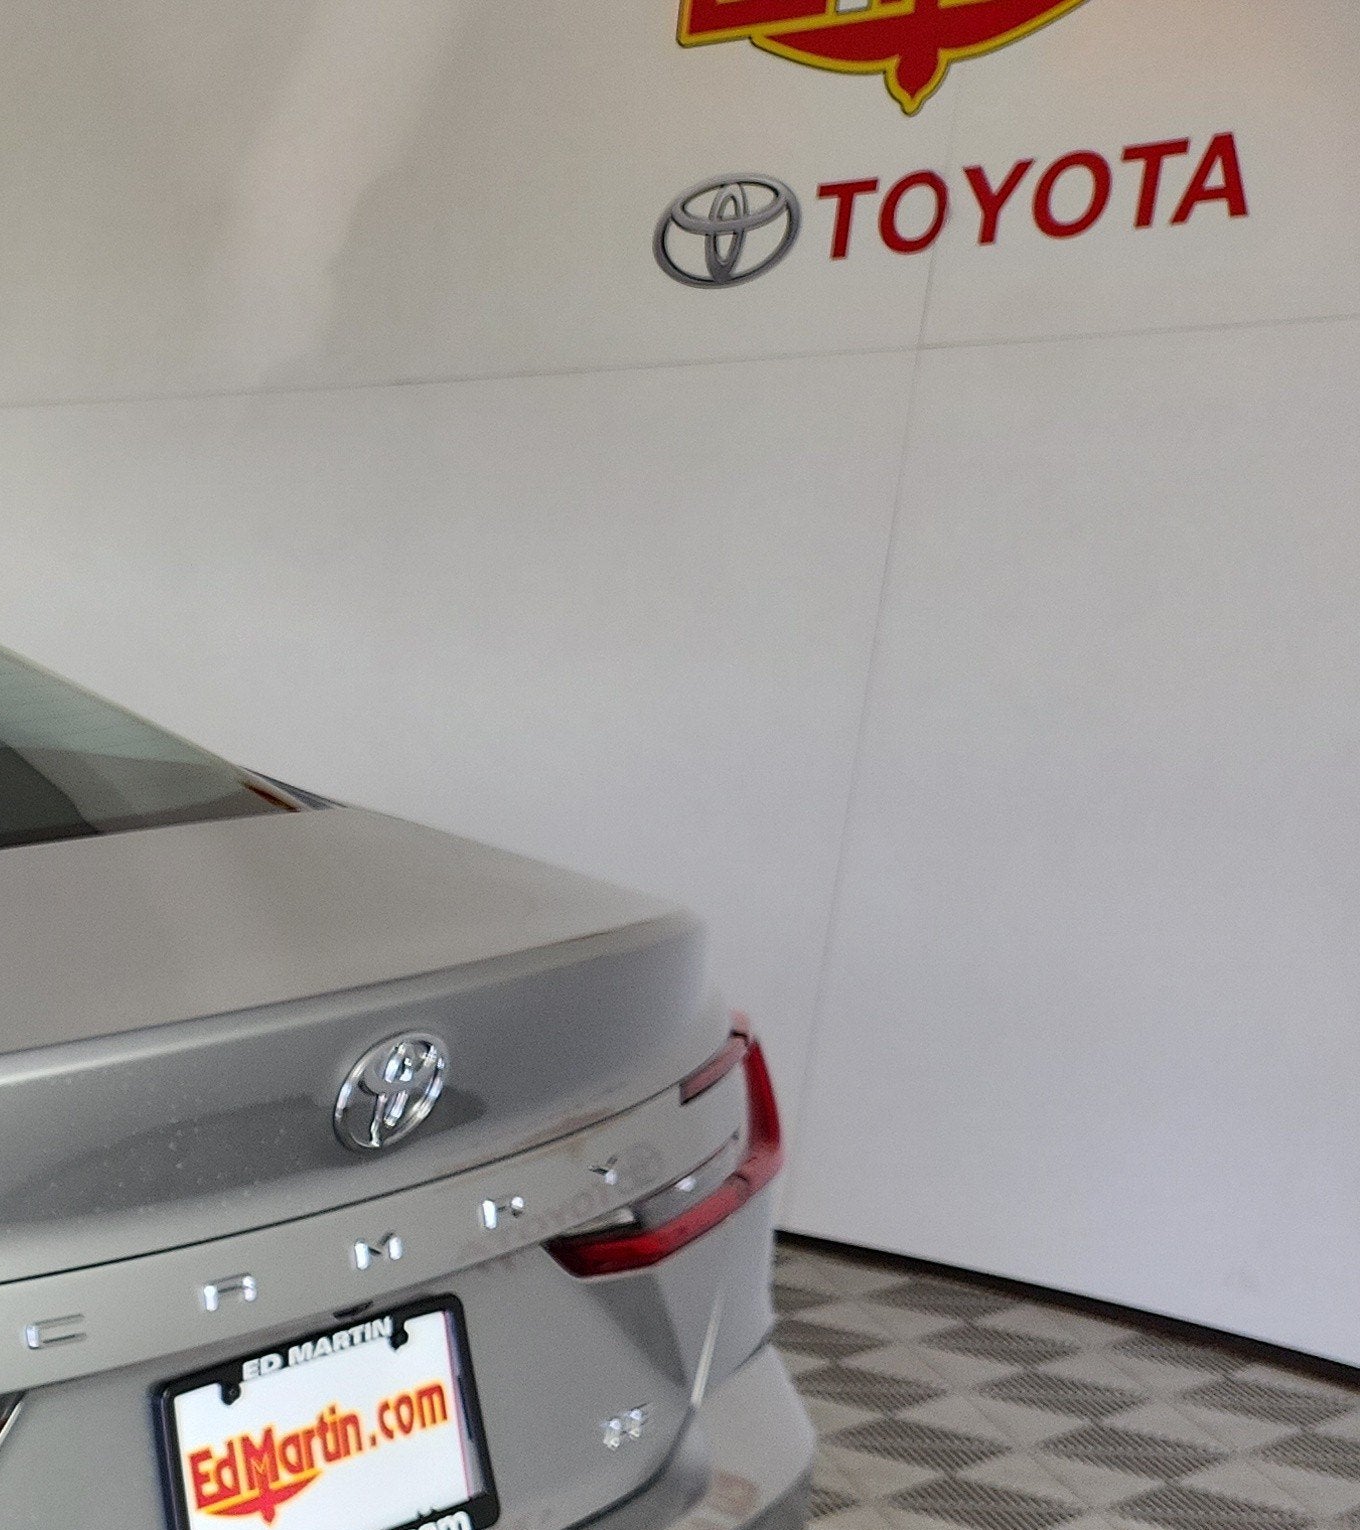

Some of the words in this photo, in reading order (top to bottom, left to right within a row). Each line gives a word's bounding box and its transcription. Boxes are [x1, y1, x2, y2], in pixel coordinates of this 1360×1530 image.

[817, 132, 1248, 260] TOYOTA
[241, 1351, 282, 1382] ED
[288, 1316, 395, 1369] MARTIN
[187, 1380, 450, 1510] EdMartin.com
